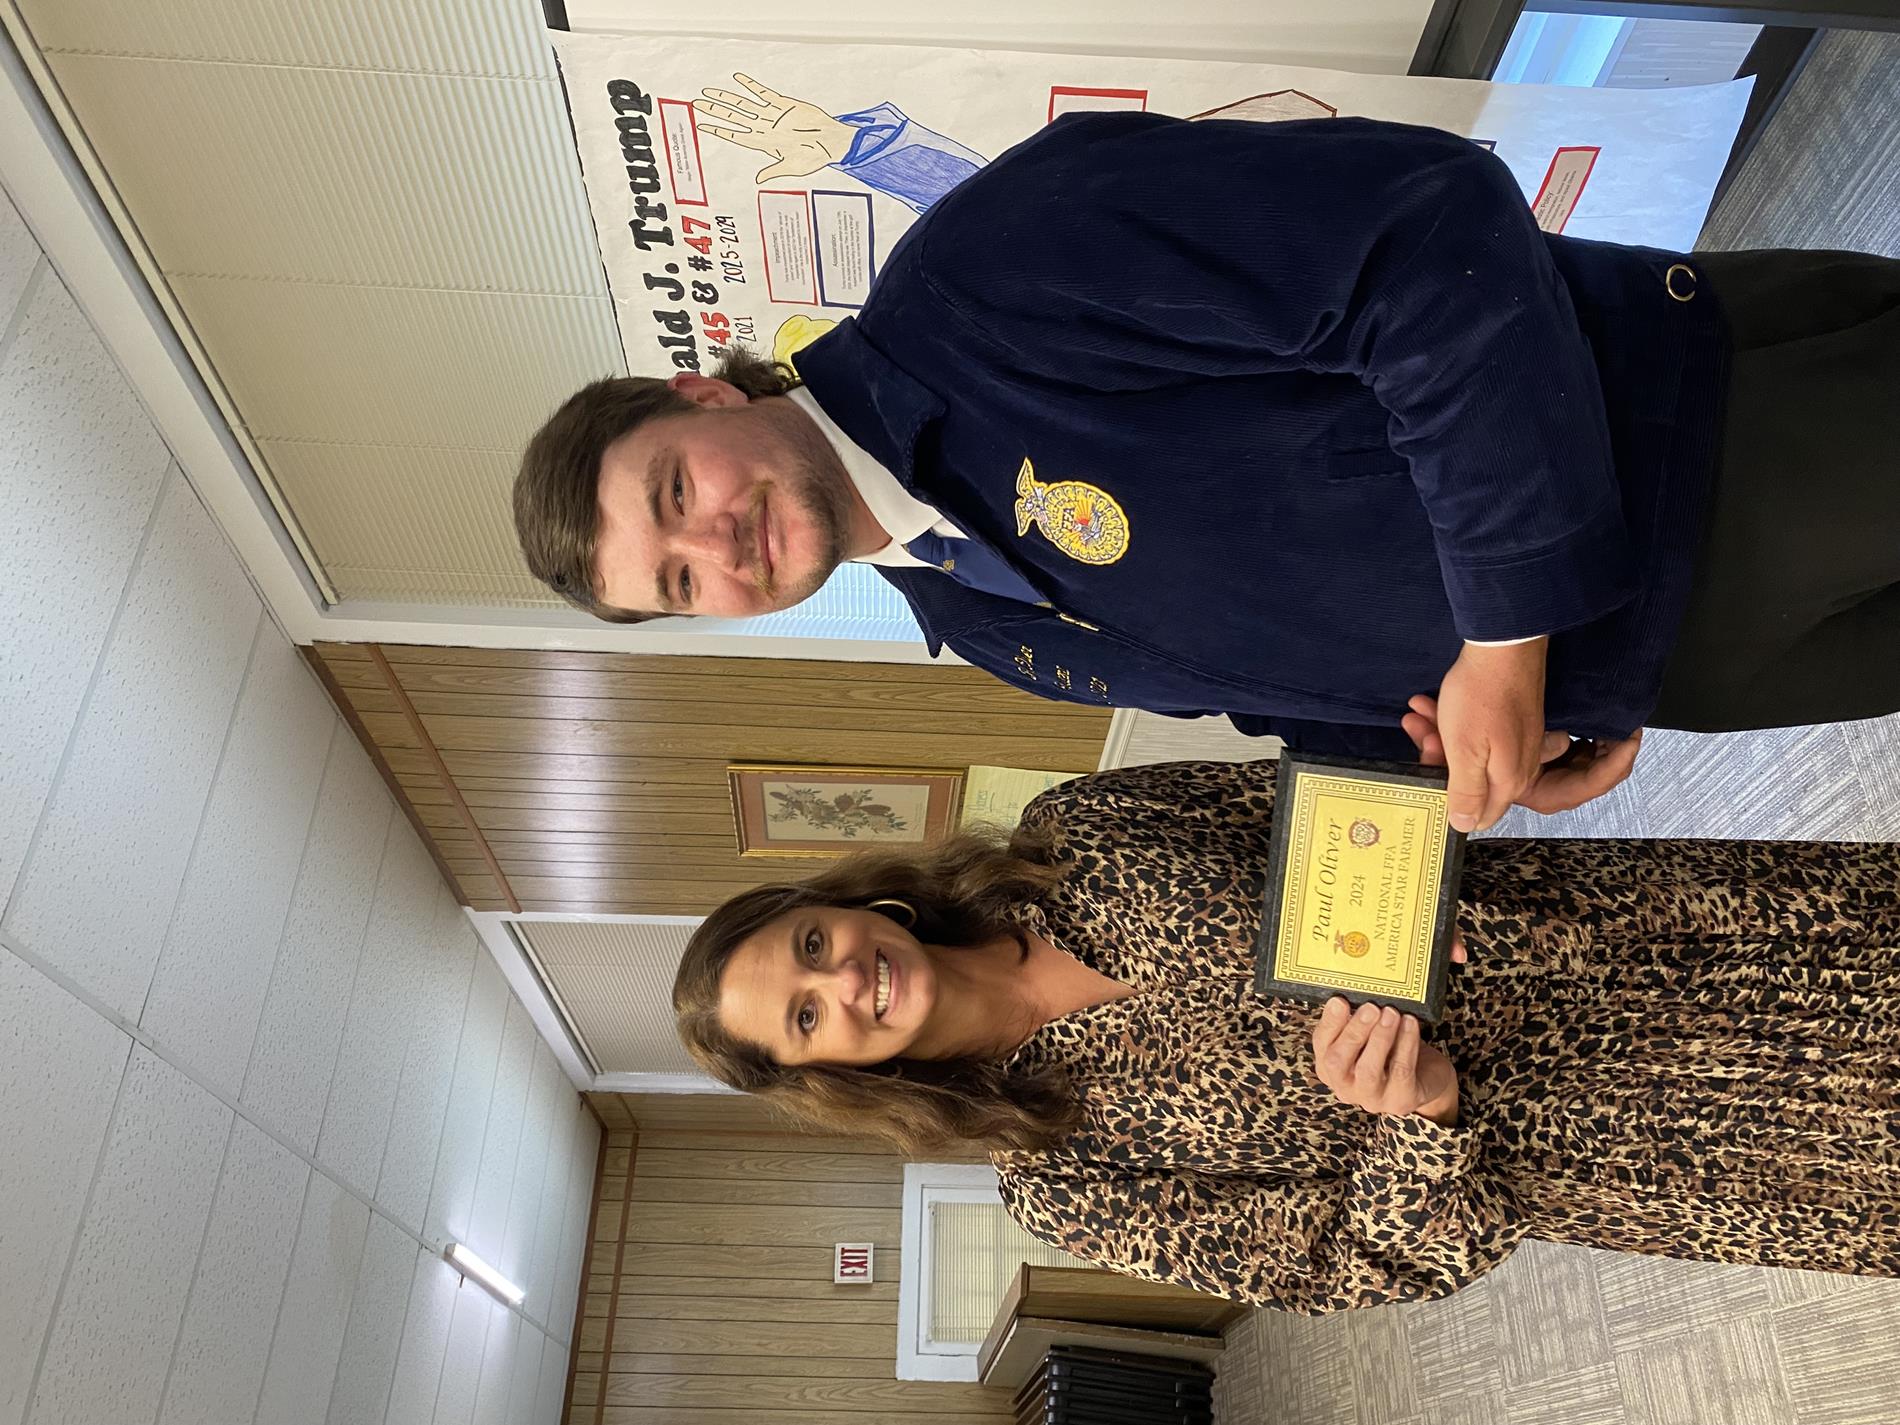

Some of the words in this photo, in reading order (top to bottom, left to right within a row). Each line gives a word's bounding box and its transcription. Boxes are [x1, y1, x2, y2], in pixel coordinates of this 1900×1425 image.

[606, 79, 674, 251] Trump
[681, 215, 714, 271] #47
[715, 215, 746, 284] 2025-2029
[642, 262, 685, 301] J.
[691, 279, 720, 305] &
[700, 311, 732, 359] #45
[1061, 507, 1076, 532] FFA
[1317, 818, 1342, 885] Oliver
[1397, 816, 1416, 873] FARMER
[1311, 886, 1334, 942] Paul
[1348, 874, 1366, 908] 2024
[1374, 873, 1392, 940] NATIONAL
[1384, 844, 1398, 870] FFA
[1393, 874, 1409, 910] STAR
[1384, 912, 1404, 972] AMERICA
[840, 1247, 868, 1277] EXIT
